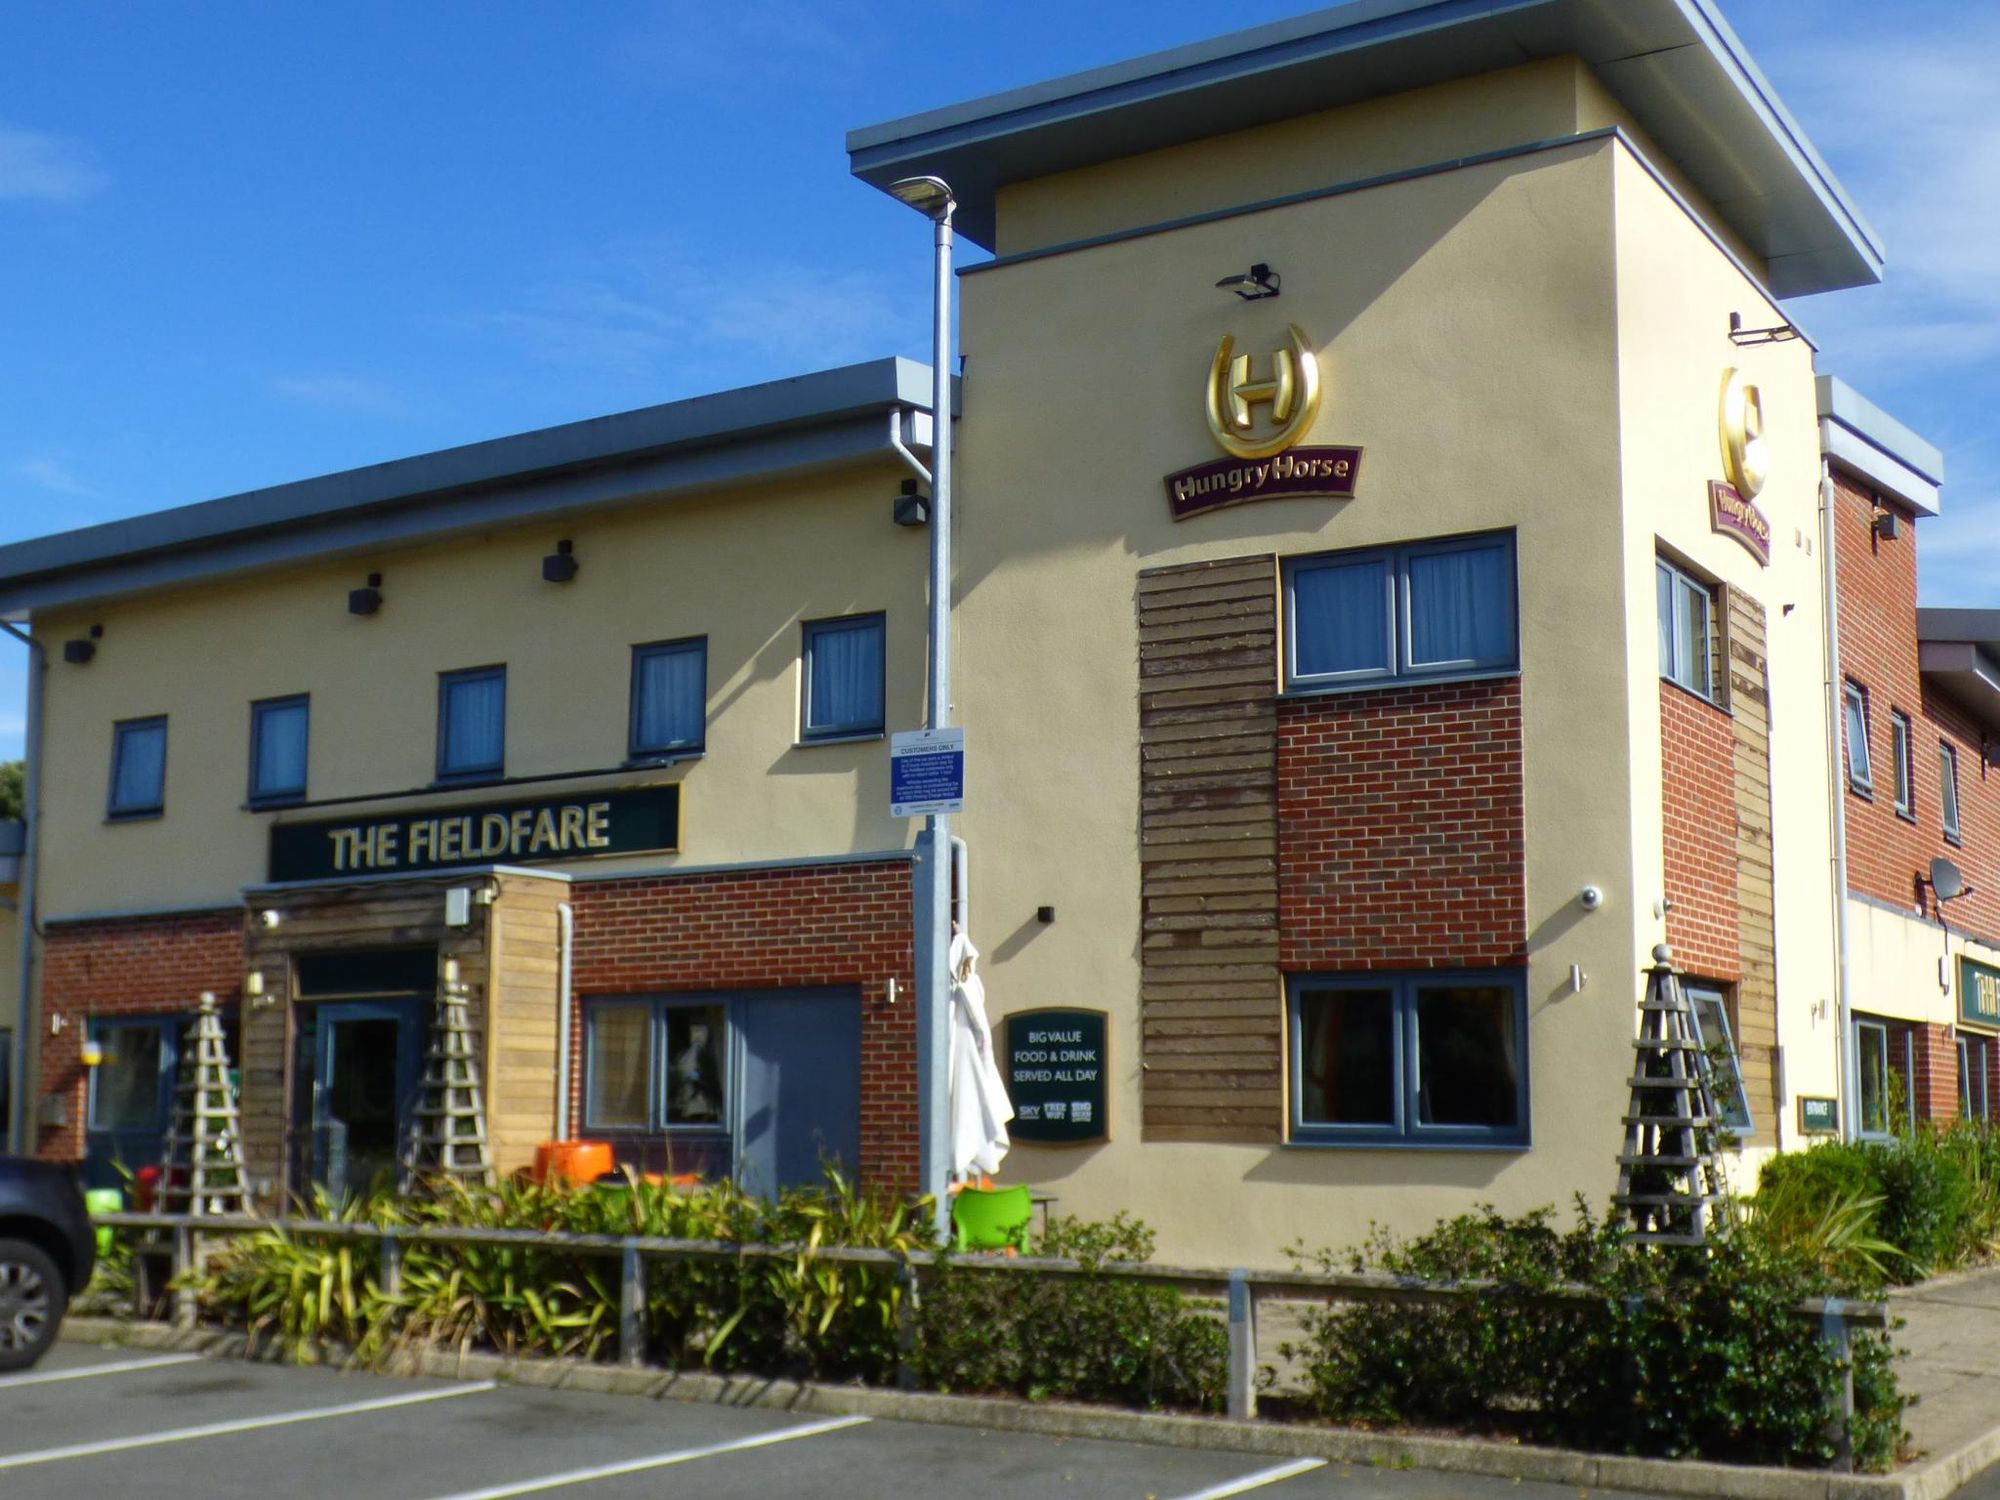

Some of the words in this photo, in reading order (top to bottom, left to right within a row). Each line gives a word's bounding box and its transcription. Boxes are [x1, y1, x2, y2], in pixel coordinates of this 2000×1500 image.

[328, 822, 399, 871] THE
[408, 802, 611, 864] FIELDFARE
[1028, 1031, 1047, 1043] BIG
[1047, 1031, 1082, 1043] VALUE
[1014, 1051, 1048, 1062] FOOD
[1049, 1051, 1058, 1062] &
[1060, 1050, 1097, 1062] DRINK
[1013, 1070, 1052, 1082] SERVED
[1054, 1070, 1074, 1081] ALL
[1075, 1070, 1098, 1081] DAY
